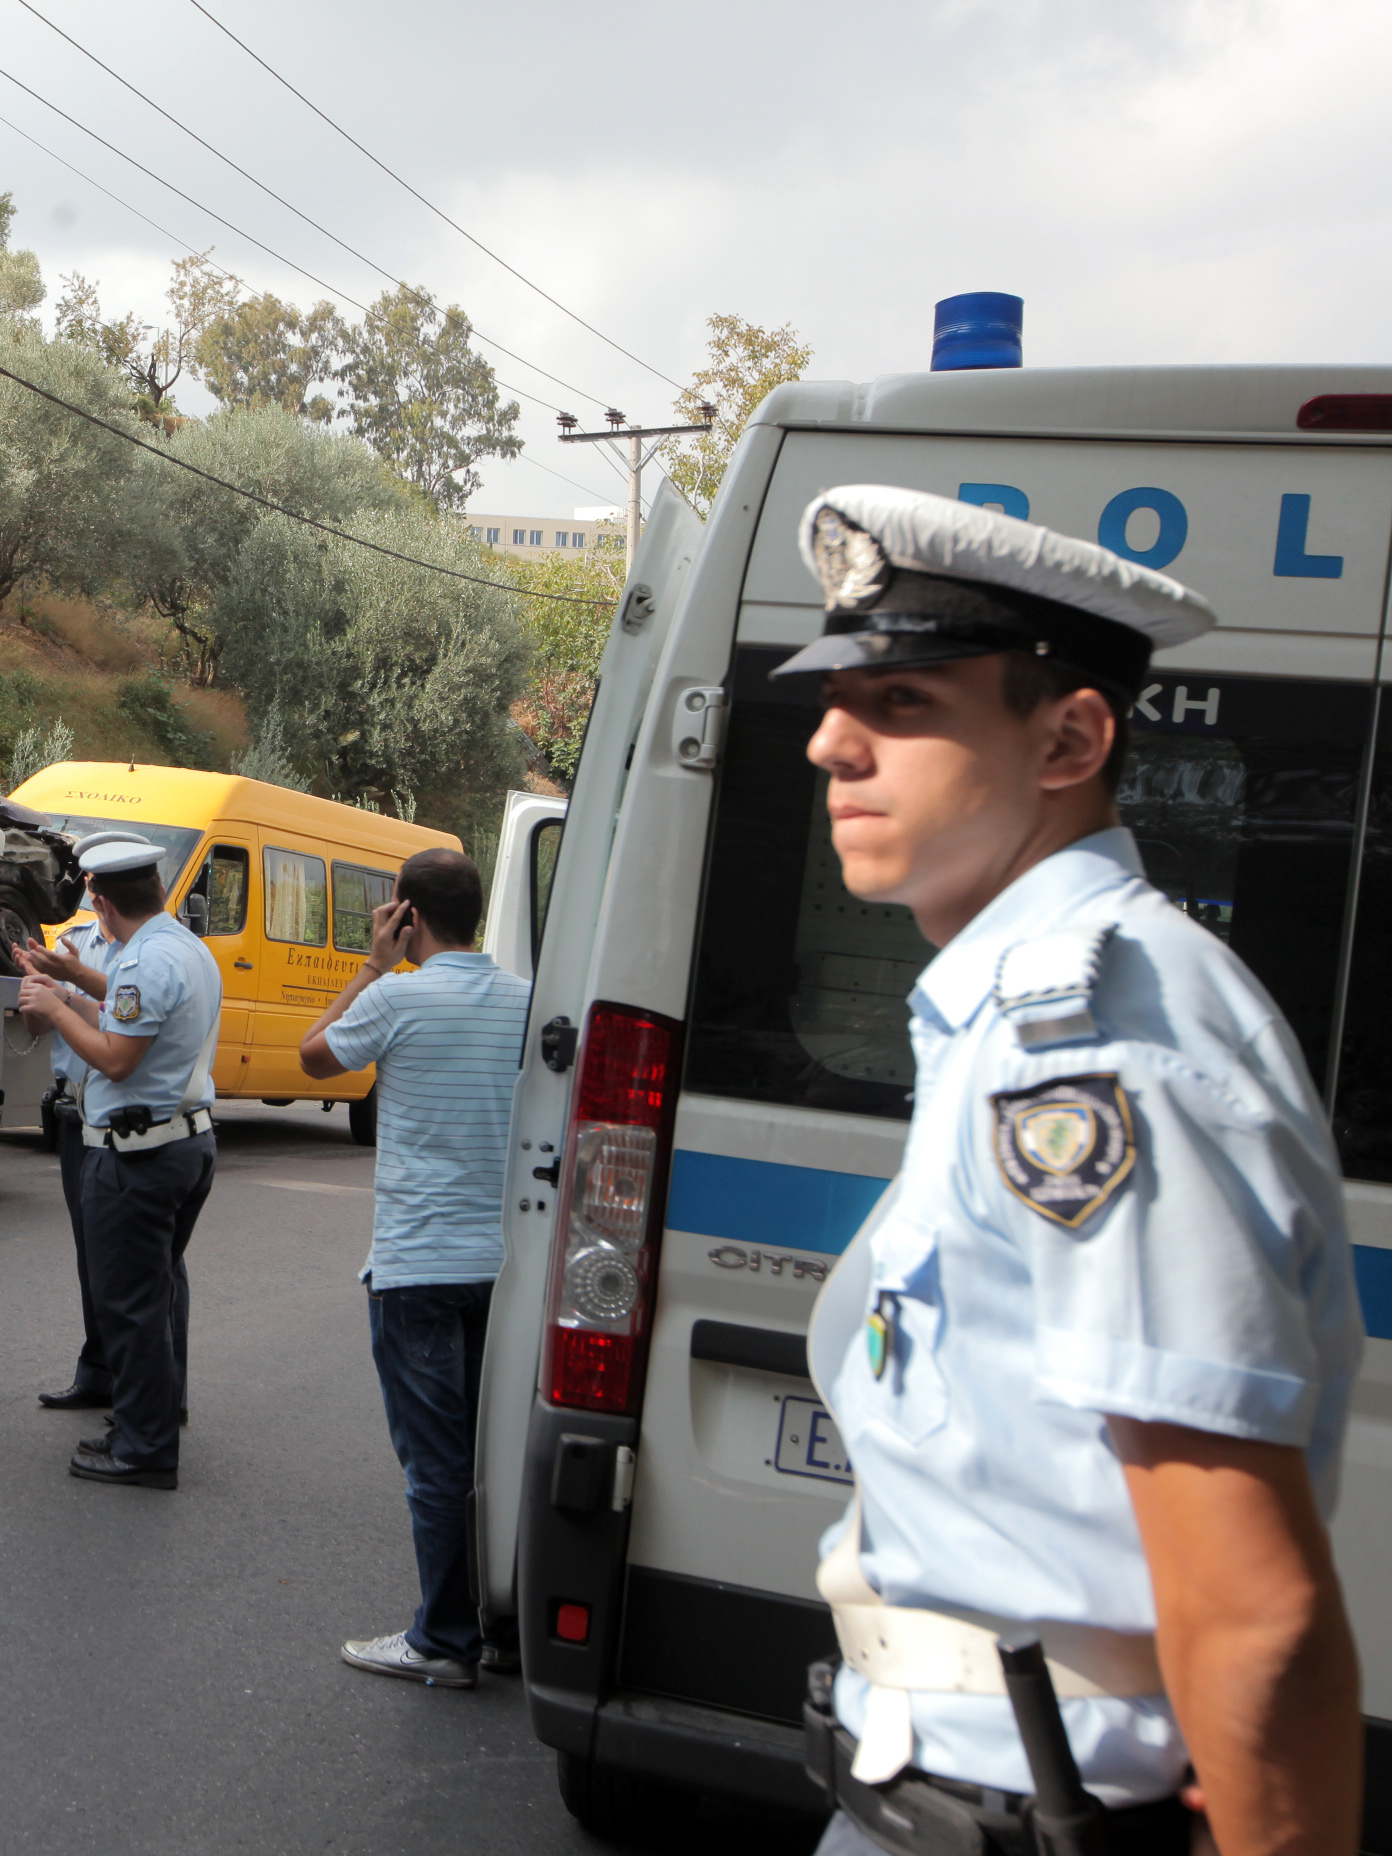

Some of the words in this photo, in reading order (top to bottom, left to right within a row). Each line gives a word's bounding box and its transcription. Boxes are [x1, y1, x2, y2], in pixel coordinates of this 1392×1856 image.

[64, 790, 142, 805] ΣΧΟΛΙΚΟ
[287, 947, 360, 975] Εκπαιδευτι
[307, 974, 352, 989] ΕΚΠΑΙΔΕΥΤ
[708, 1246, 830, 1281] CITR
